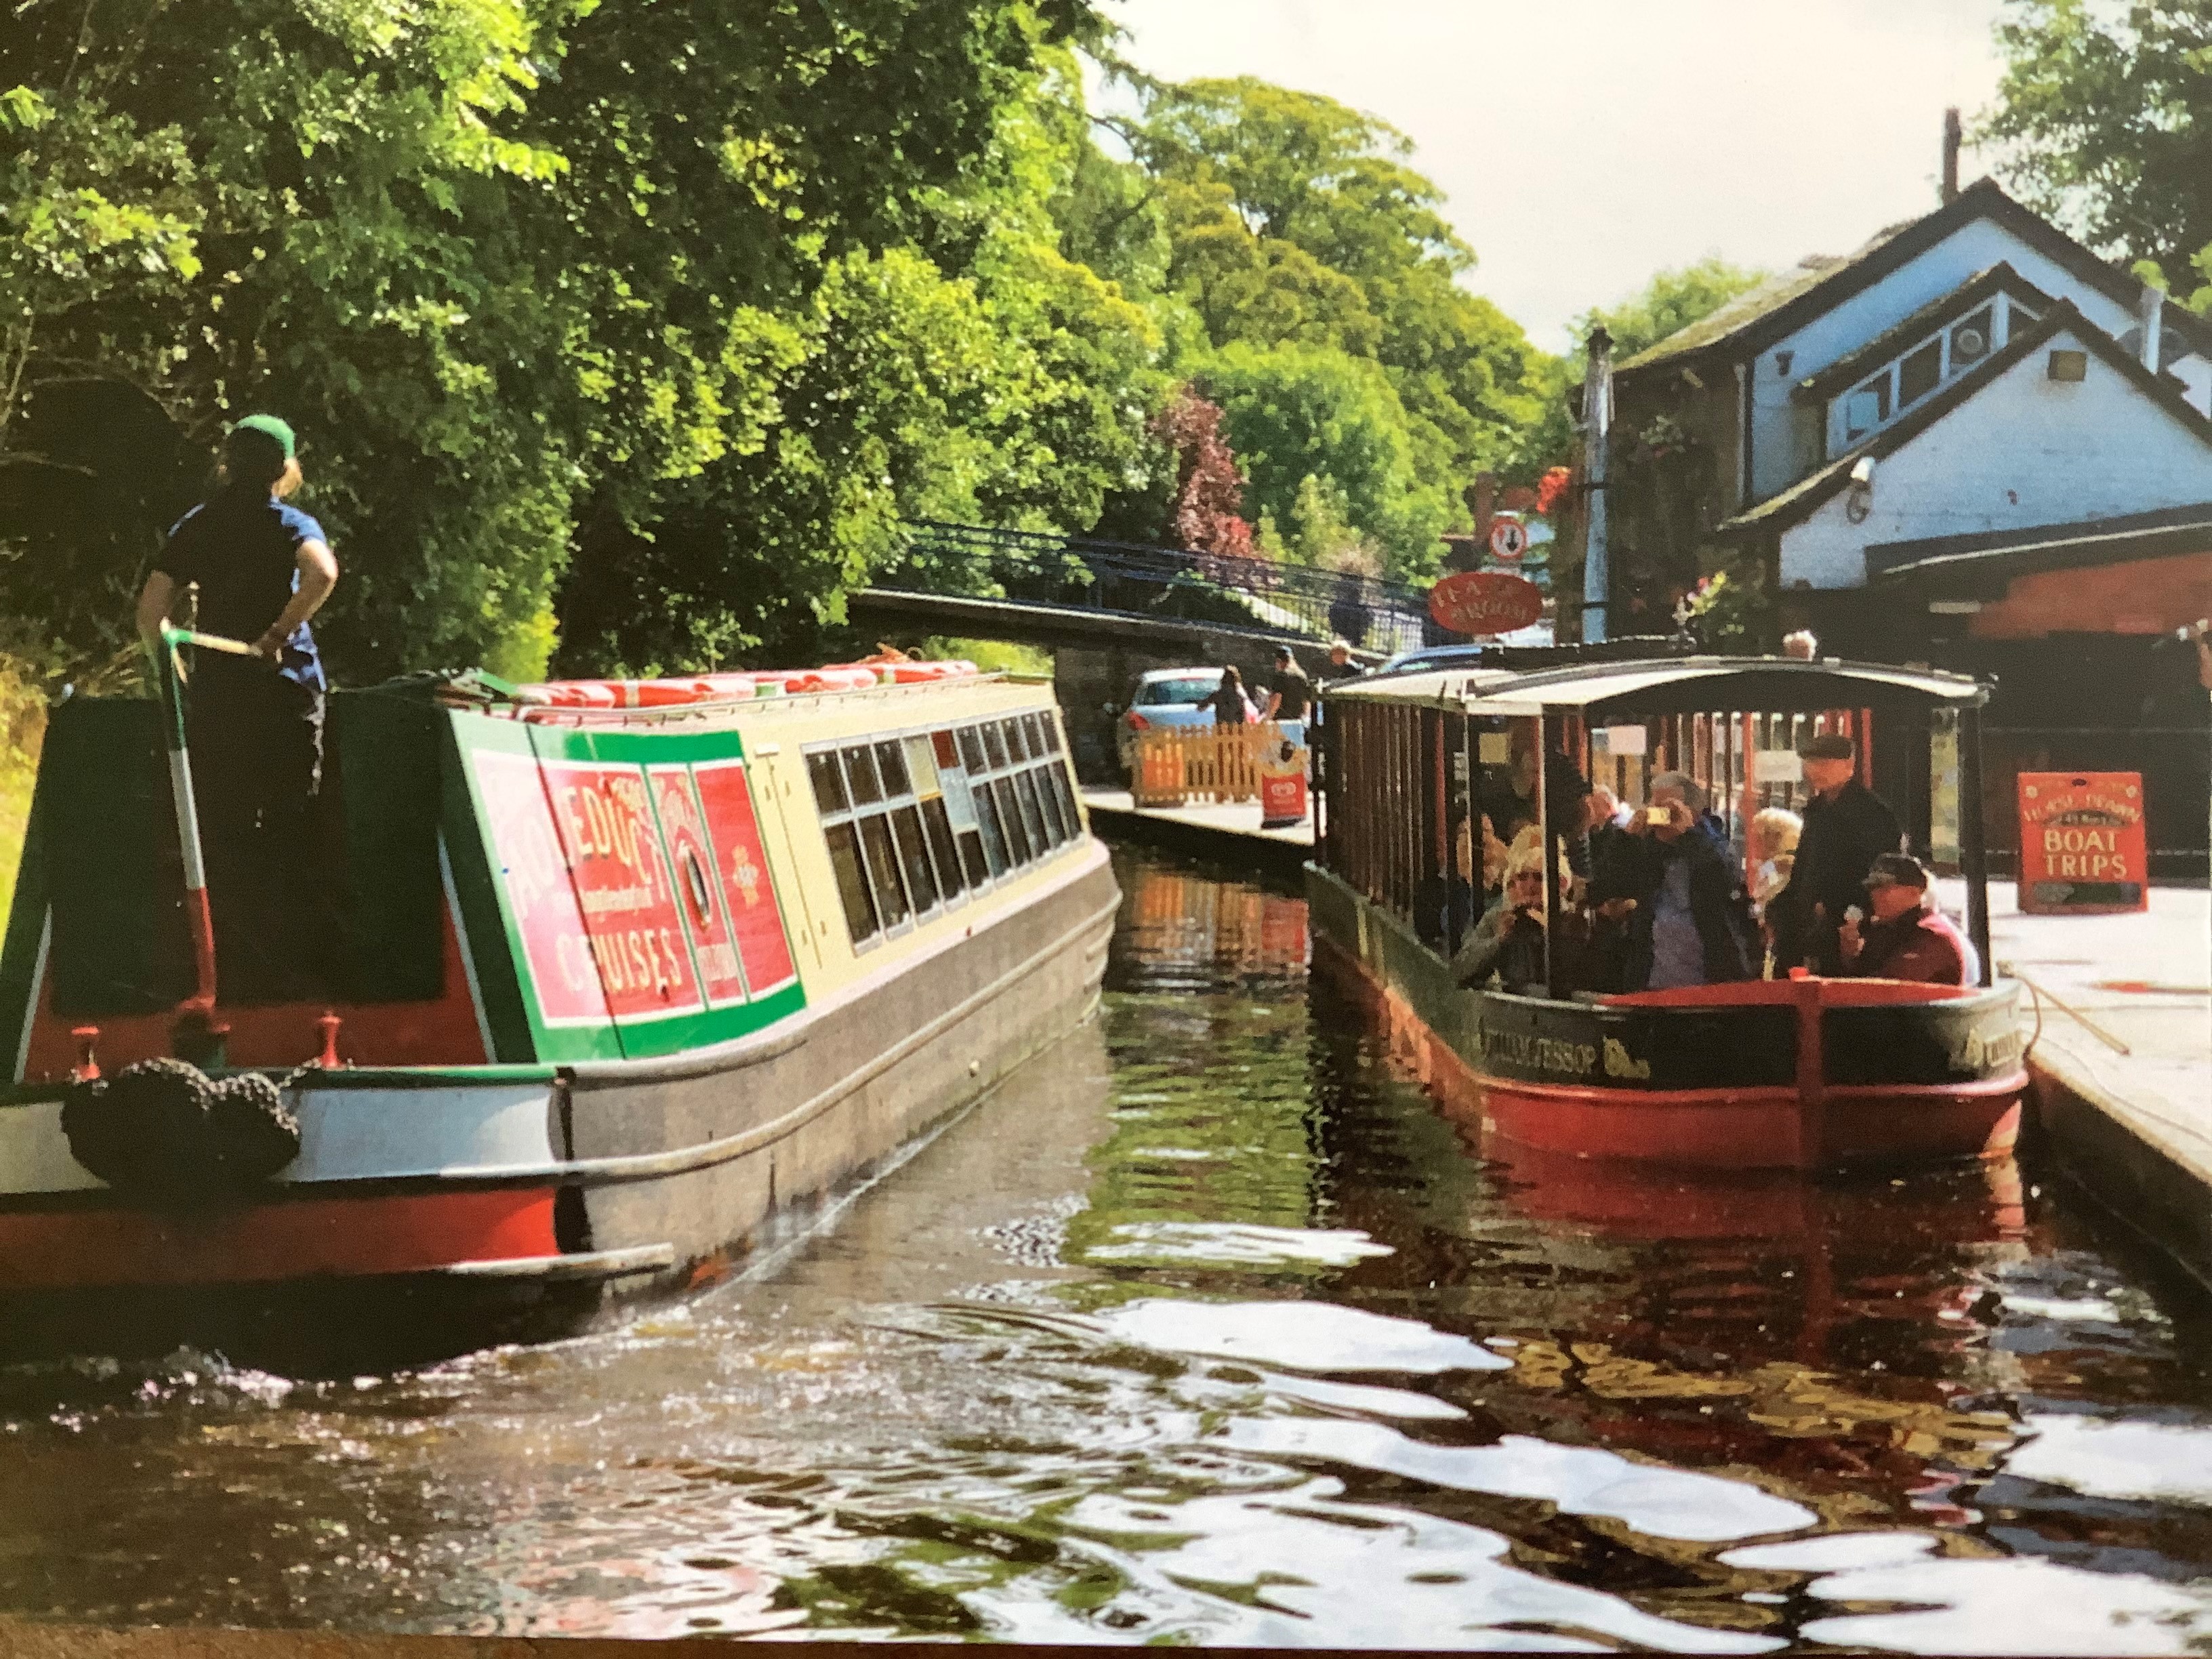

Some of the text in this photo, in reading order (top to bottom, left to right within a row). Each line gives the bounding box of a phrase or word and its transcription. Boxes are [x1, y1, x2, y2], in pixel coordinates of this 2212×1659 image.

[2043, 829, 2119, 853] BOAT
[2045, 854, 2128, 879] TRIPS
[555, 927, 684, 995] CRUISES
